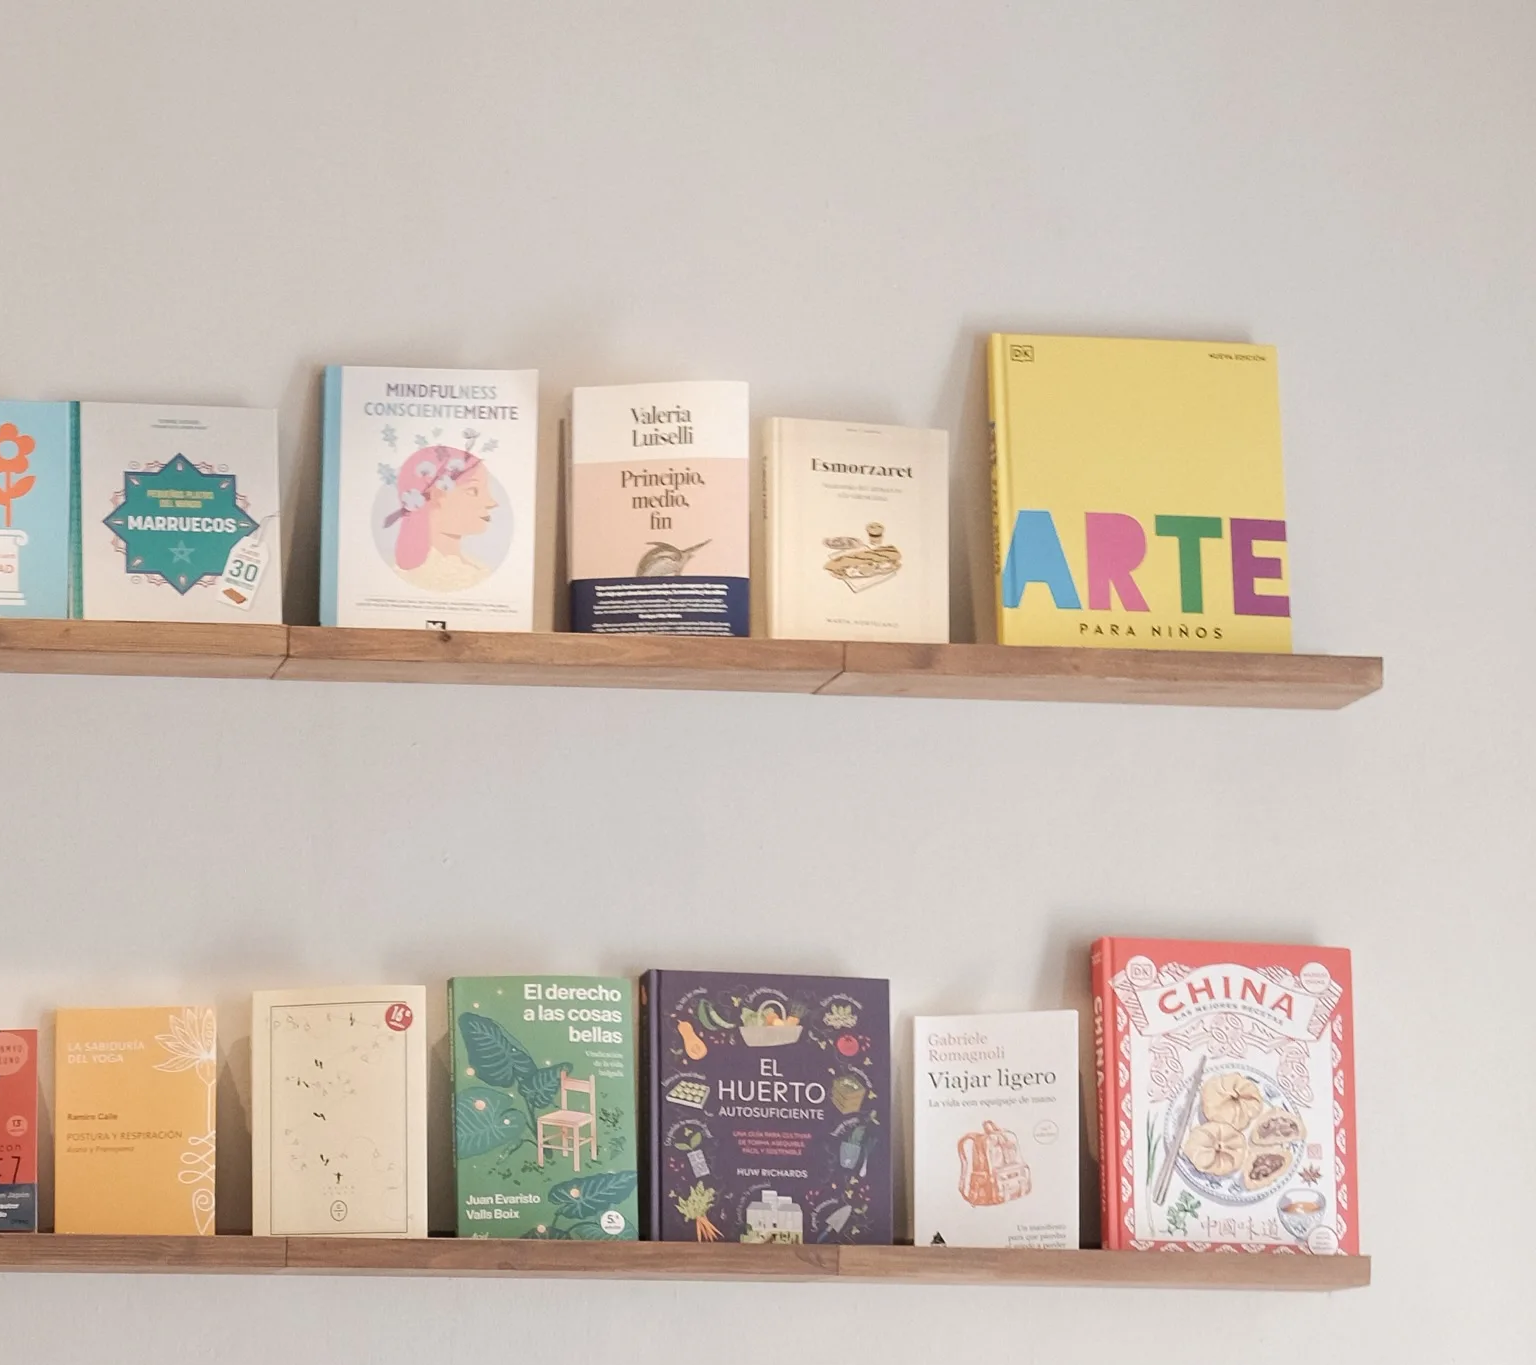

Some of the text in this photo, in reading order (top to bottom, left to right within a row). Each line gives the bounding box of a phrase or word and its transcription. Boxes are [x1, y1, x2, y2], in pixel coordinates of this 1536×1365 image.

[386, 383, 498, 400] MINDFULNESS
[364, 401, 520, 422] CONSCIENTEMENTE
[630, 406, 692, 424] Valeria
[632, 426, 694, 448] Luiselli
[621, 468, 706, 490] Principio,
[632, 489, 690, 508] medio,
[127, 515, 238, 533] MARRUECOS
[229, 559, 258, 583] 30
[1002, 510, 1291, 617] ARTE
[1079, 623, 1224, 639] PARA NIÑOS
[524, 983, 622, 1002] El derecho
[1158, 975, 1295, 1021] CHINA
[523, 1004, 623, 1023] a las cosas
[1173, 1002, 1284, 1027] LAS MEJORES RECETAS
[568, 1026, 623, 1043] bellas
[927, 1031, 988, 1047] Gabriele
[1092, 995, 1105, 1088] CHINA
[928, 1046, 1005, 1063] Romagnoli
[759, 1058, 784, 1077] EL
[928, 1068, 1057, 1093] Viajar ligero
[718, 1079, 826, 1104] HUERTO
[928, 1099, 940, 1107] La
[941, 1098, 960, 1107] vida
[962, 1099, 977, 1107] con
[979, 1096, 1017, 1108] equipaje
[1019, 1095, 1030, 1104] de
[718, 1105, 825, 1120] AUTOSUFICIENTE
[0, 1144, 22, 1152] con
[466, 1193, 541, 1205] Juan Evaristo
